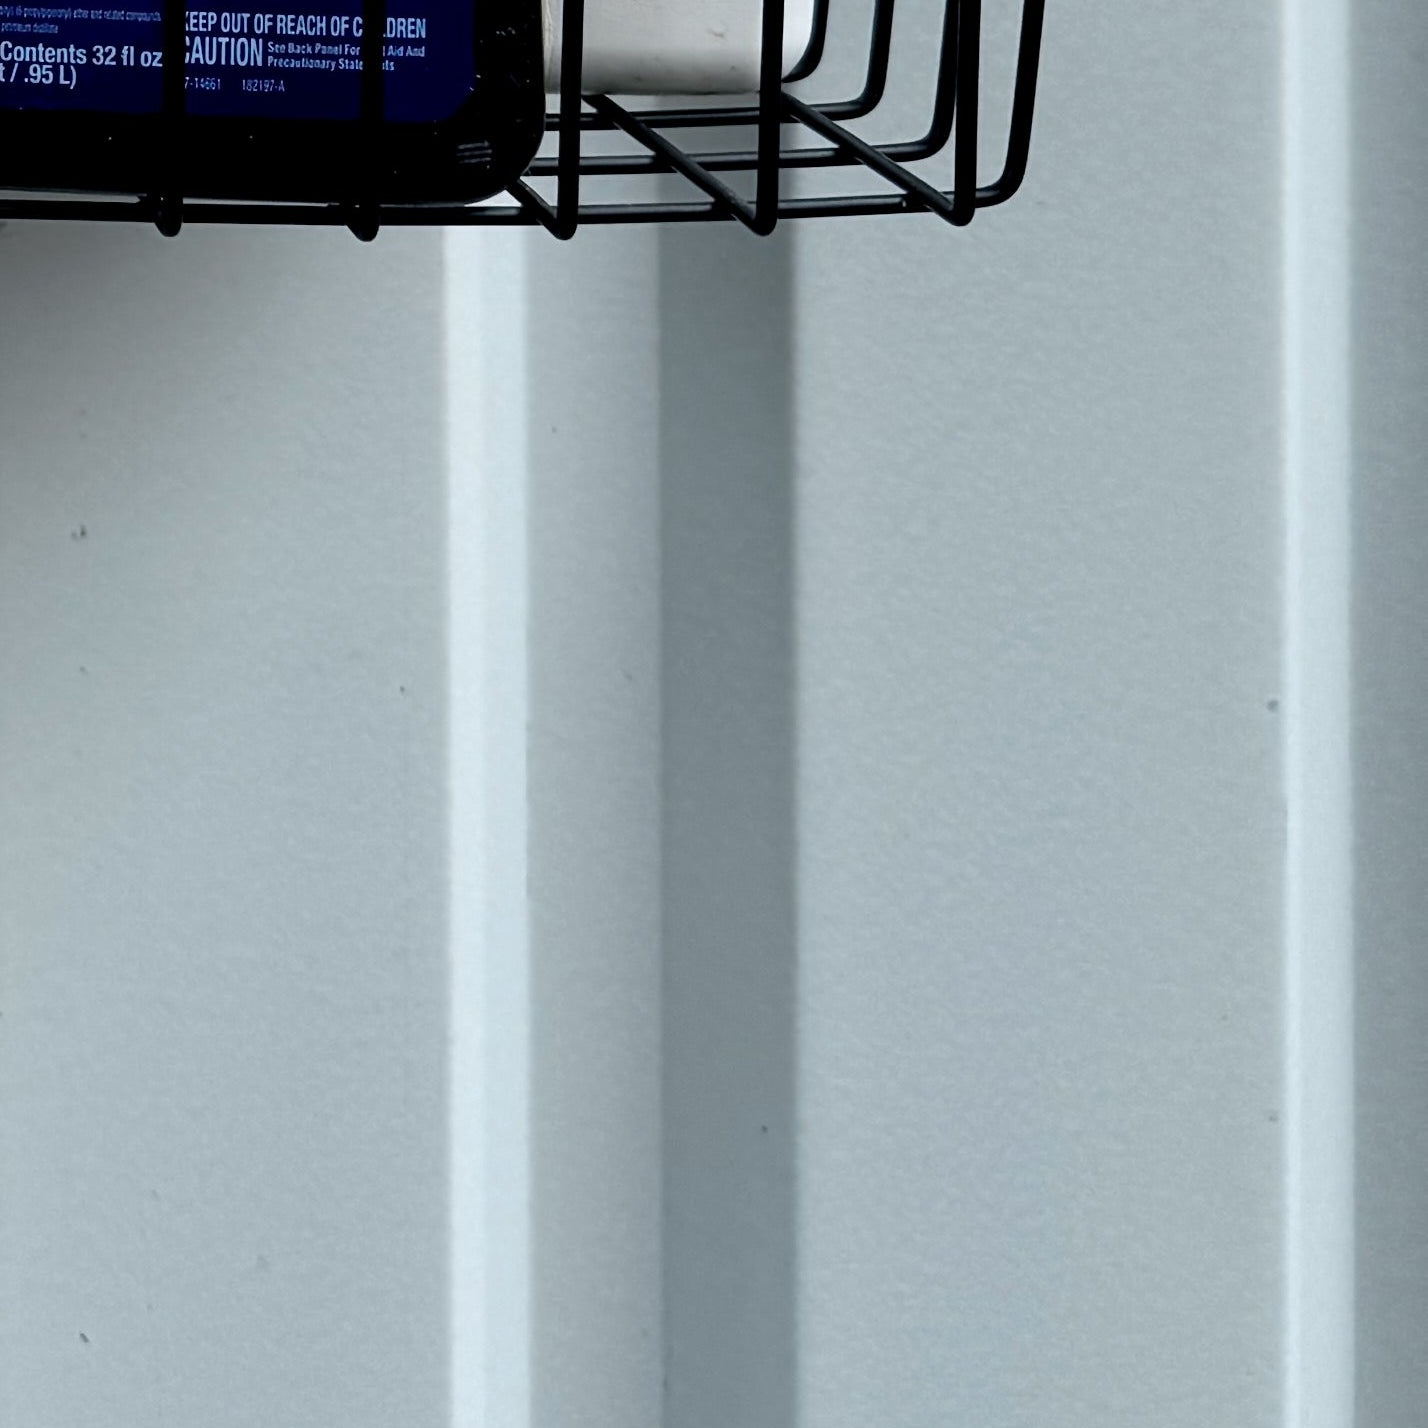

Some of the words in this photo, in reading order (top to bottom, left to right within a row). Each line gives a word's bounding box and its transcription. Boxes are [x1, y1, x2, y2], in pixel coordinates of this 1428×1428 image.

[221, 12, 251, 34] OUT
[254, 13, 274, 35] OF
[276, 14, 326, 36] REACH
[330, 15, 350, 37] OF
[0, 41, 87, 65] Contents
[92, 45, 117, 66] 32
[121, 45, 135, 67] fl
[140, 51, 163, 68] oz
[288, 42, 313, 55] Back
[314, 43, 342, 56] Panel
[344, 44, 360, 56] For
[23, 64, 53, 84] .95
[59, 65, 77, 90] L)
